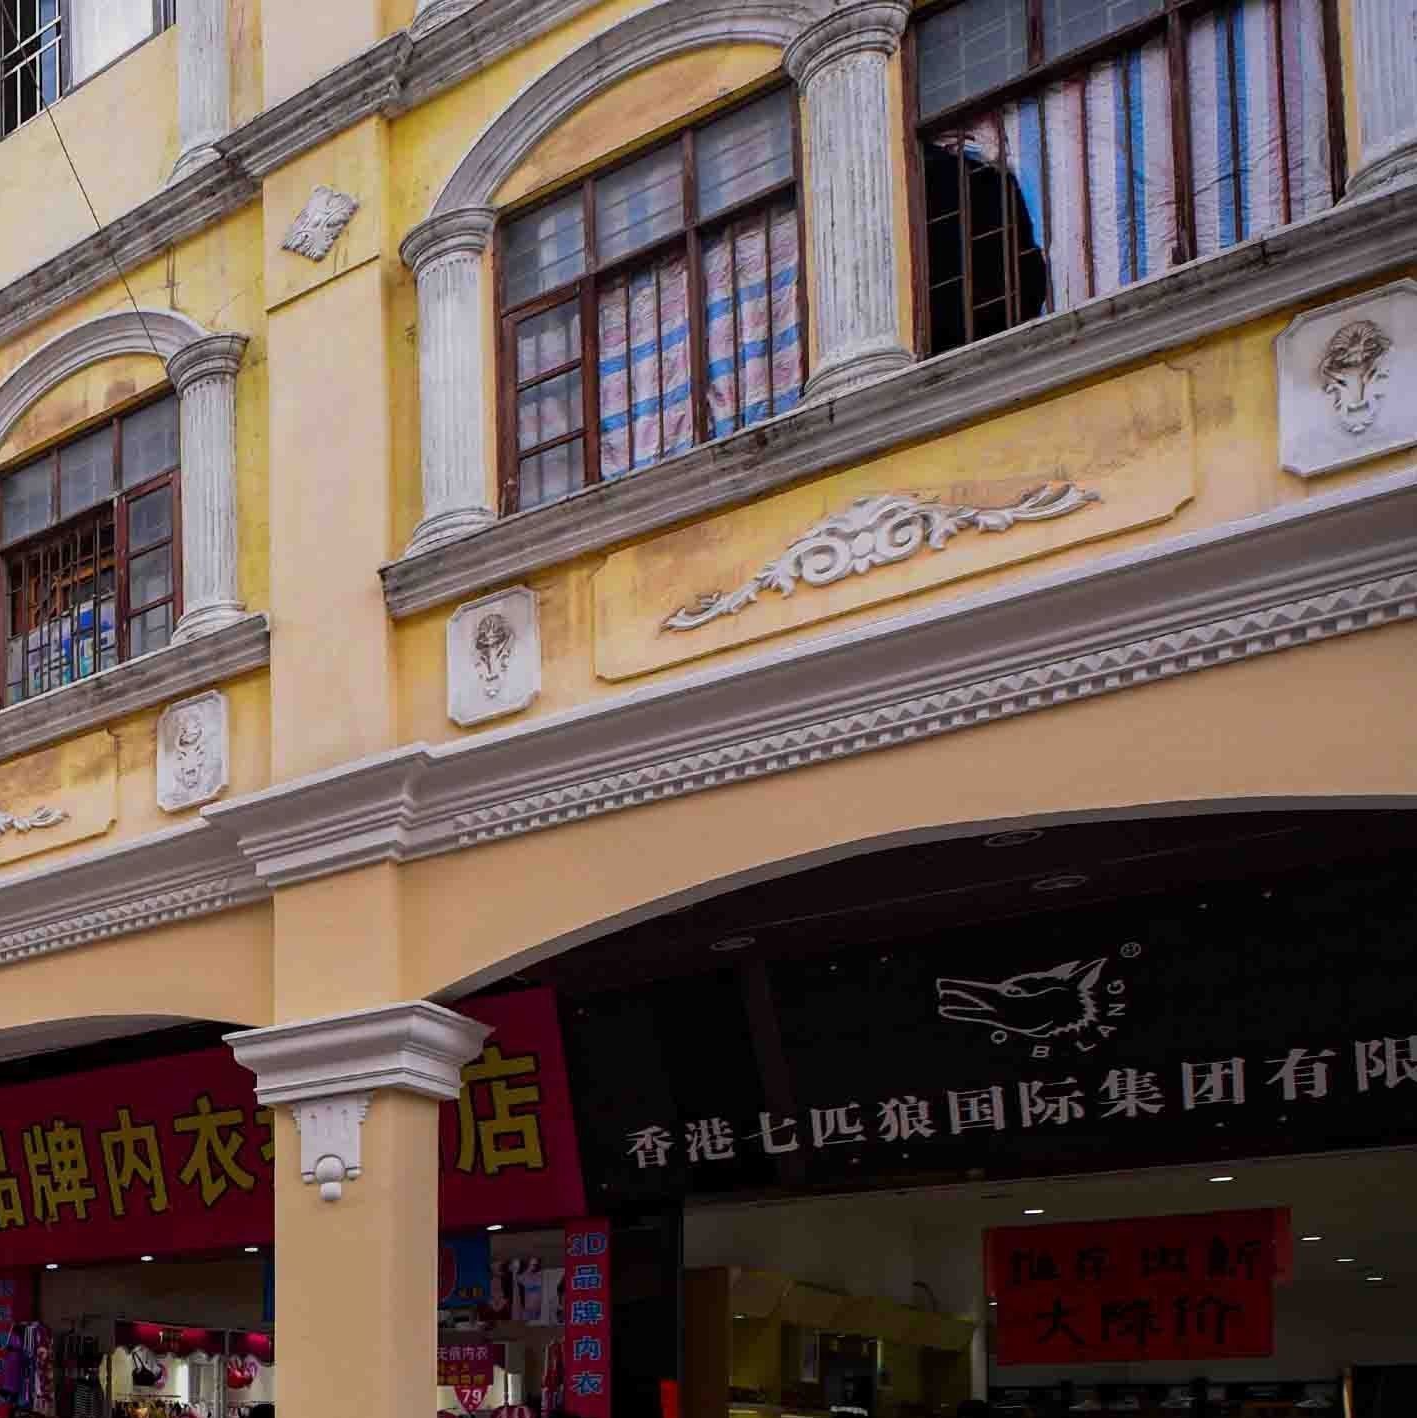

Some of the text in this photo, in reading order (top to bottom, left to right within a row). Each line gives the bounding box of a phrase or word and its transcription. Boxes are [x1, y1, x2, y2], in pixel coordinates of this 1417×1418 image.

[625, 1034, 1417, 1169] 香港七匹狼国际集团有限
[460, 1388, 483, 1405] 79
